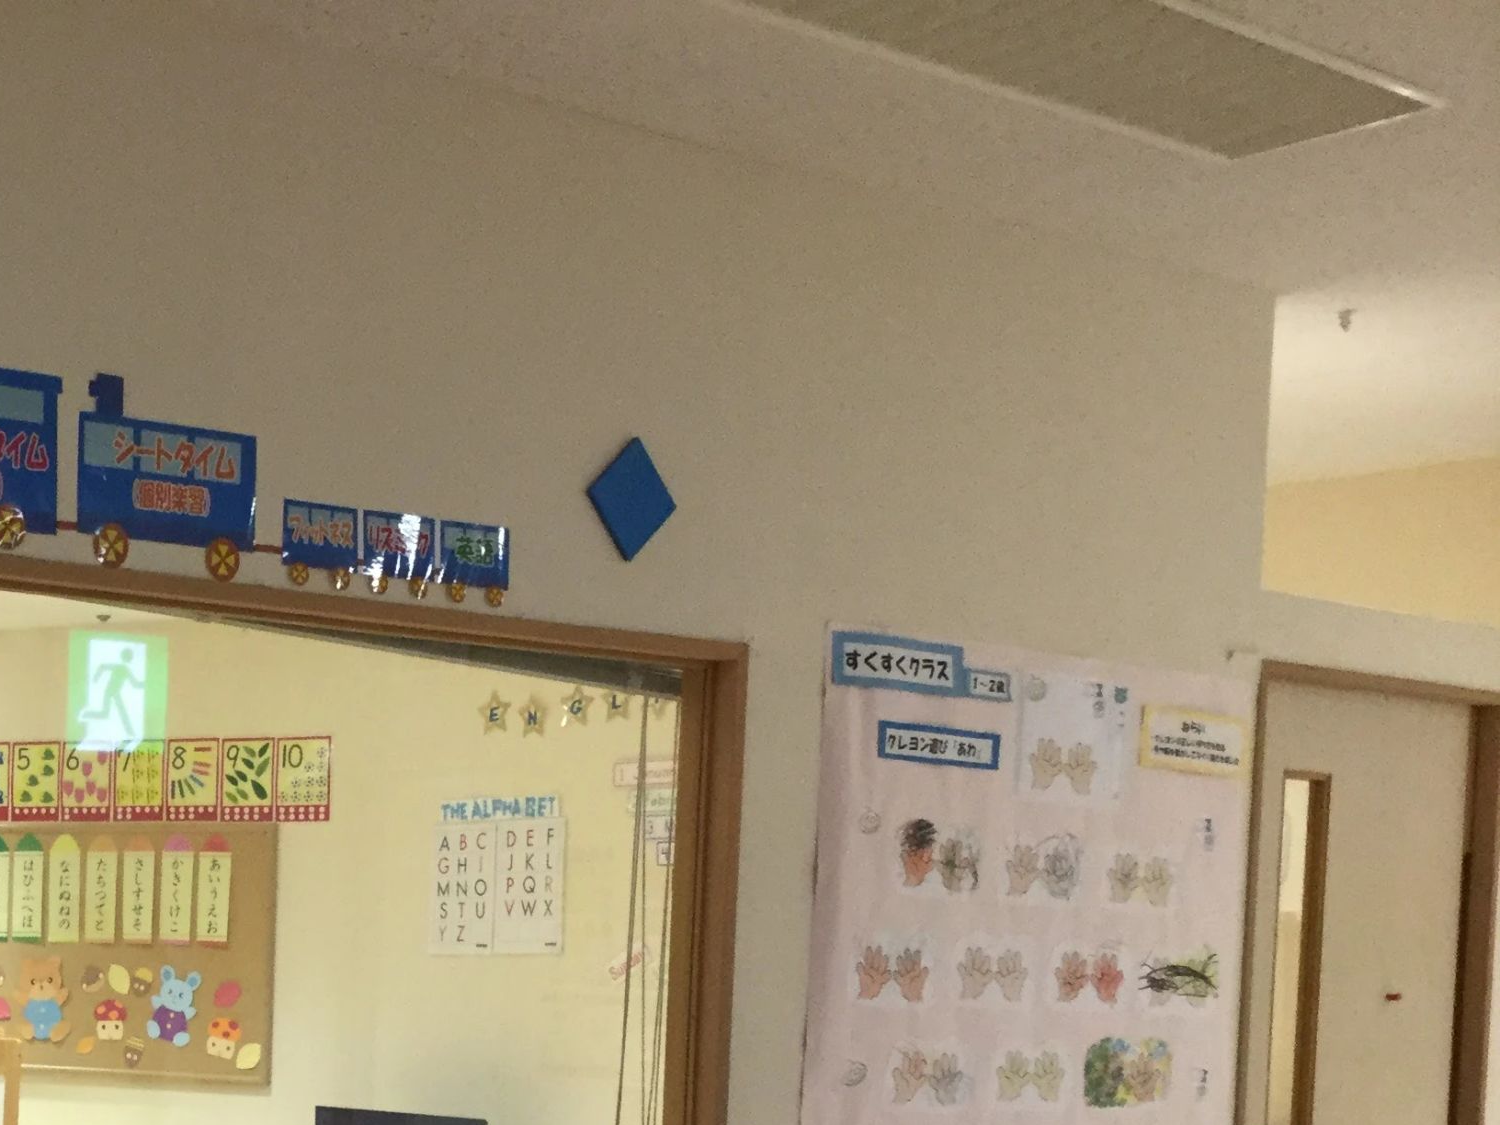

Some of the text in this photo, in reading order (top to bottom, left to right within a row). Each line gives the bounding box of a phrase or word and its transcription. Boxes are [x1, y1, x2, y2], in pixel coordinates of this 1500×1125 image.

[113, 431, 237, 480] シートタイム
[845, 650, 950, 681] すくすくクラス
[17, 748, 30, 770] 5
[66, 748, 79, 770] 6
[171, 746, 187, 770] 8
[227, 745, 240, 768] 9
[282, 744, 303, 768] 10
[441, 797, 555, 820] THE ALPHABET
[439, 829, 554, 851] A B C D E F
[438, 857, 449, 873] G
[457, 858, 467, 873] H
[507, 855, 513, 870] J
[525, 854, 534, 869] K
[546, 853, 553, 868] L
[22, 860, 35, 928] はひふへほ
[58, 860, 71, 930] なにぬねの
[95, 858, 107, 931] たちつてと
[132, 858, 144, 931] さしすせそ
[169, 859, 184, 932] かきくけこ
[206, 858, 221, 934] あいうえお
[437, 876, 553, 896] M N O P Q R
[440, 900, 553, 919] S T U V W X
[457, 926, 465, 941] Z
